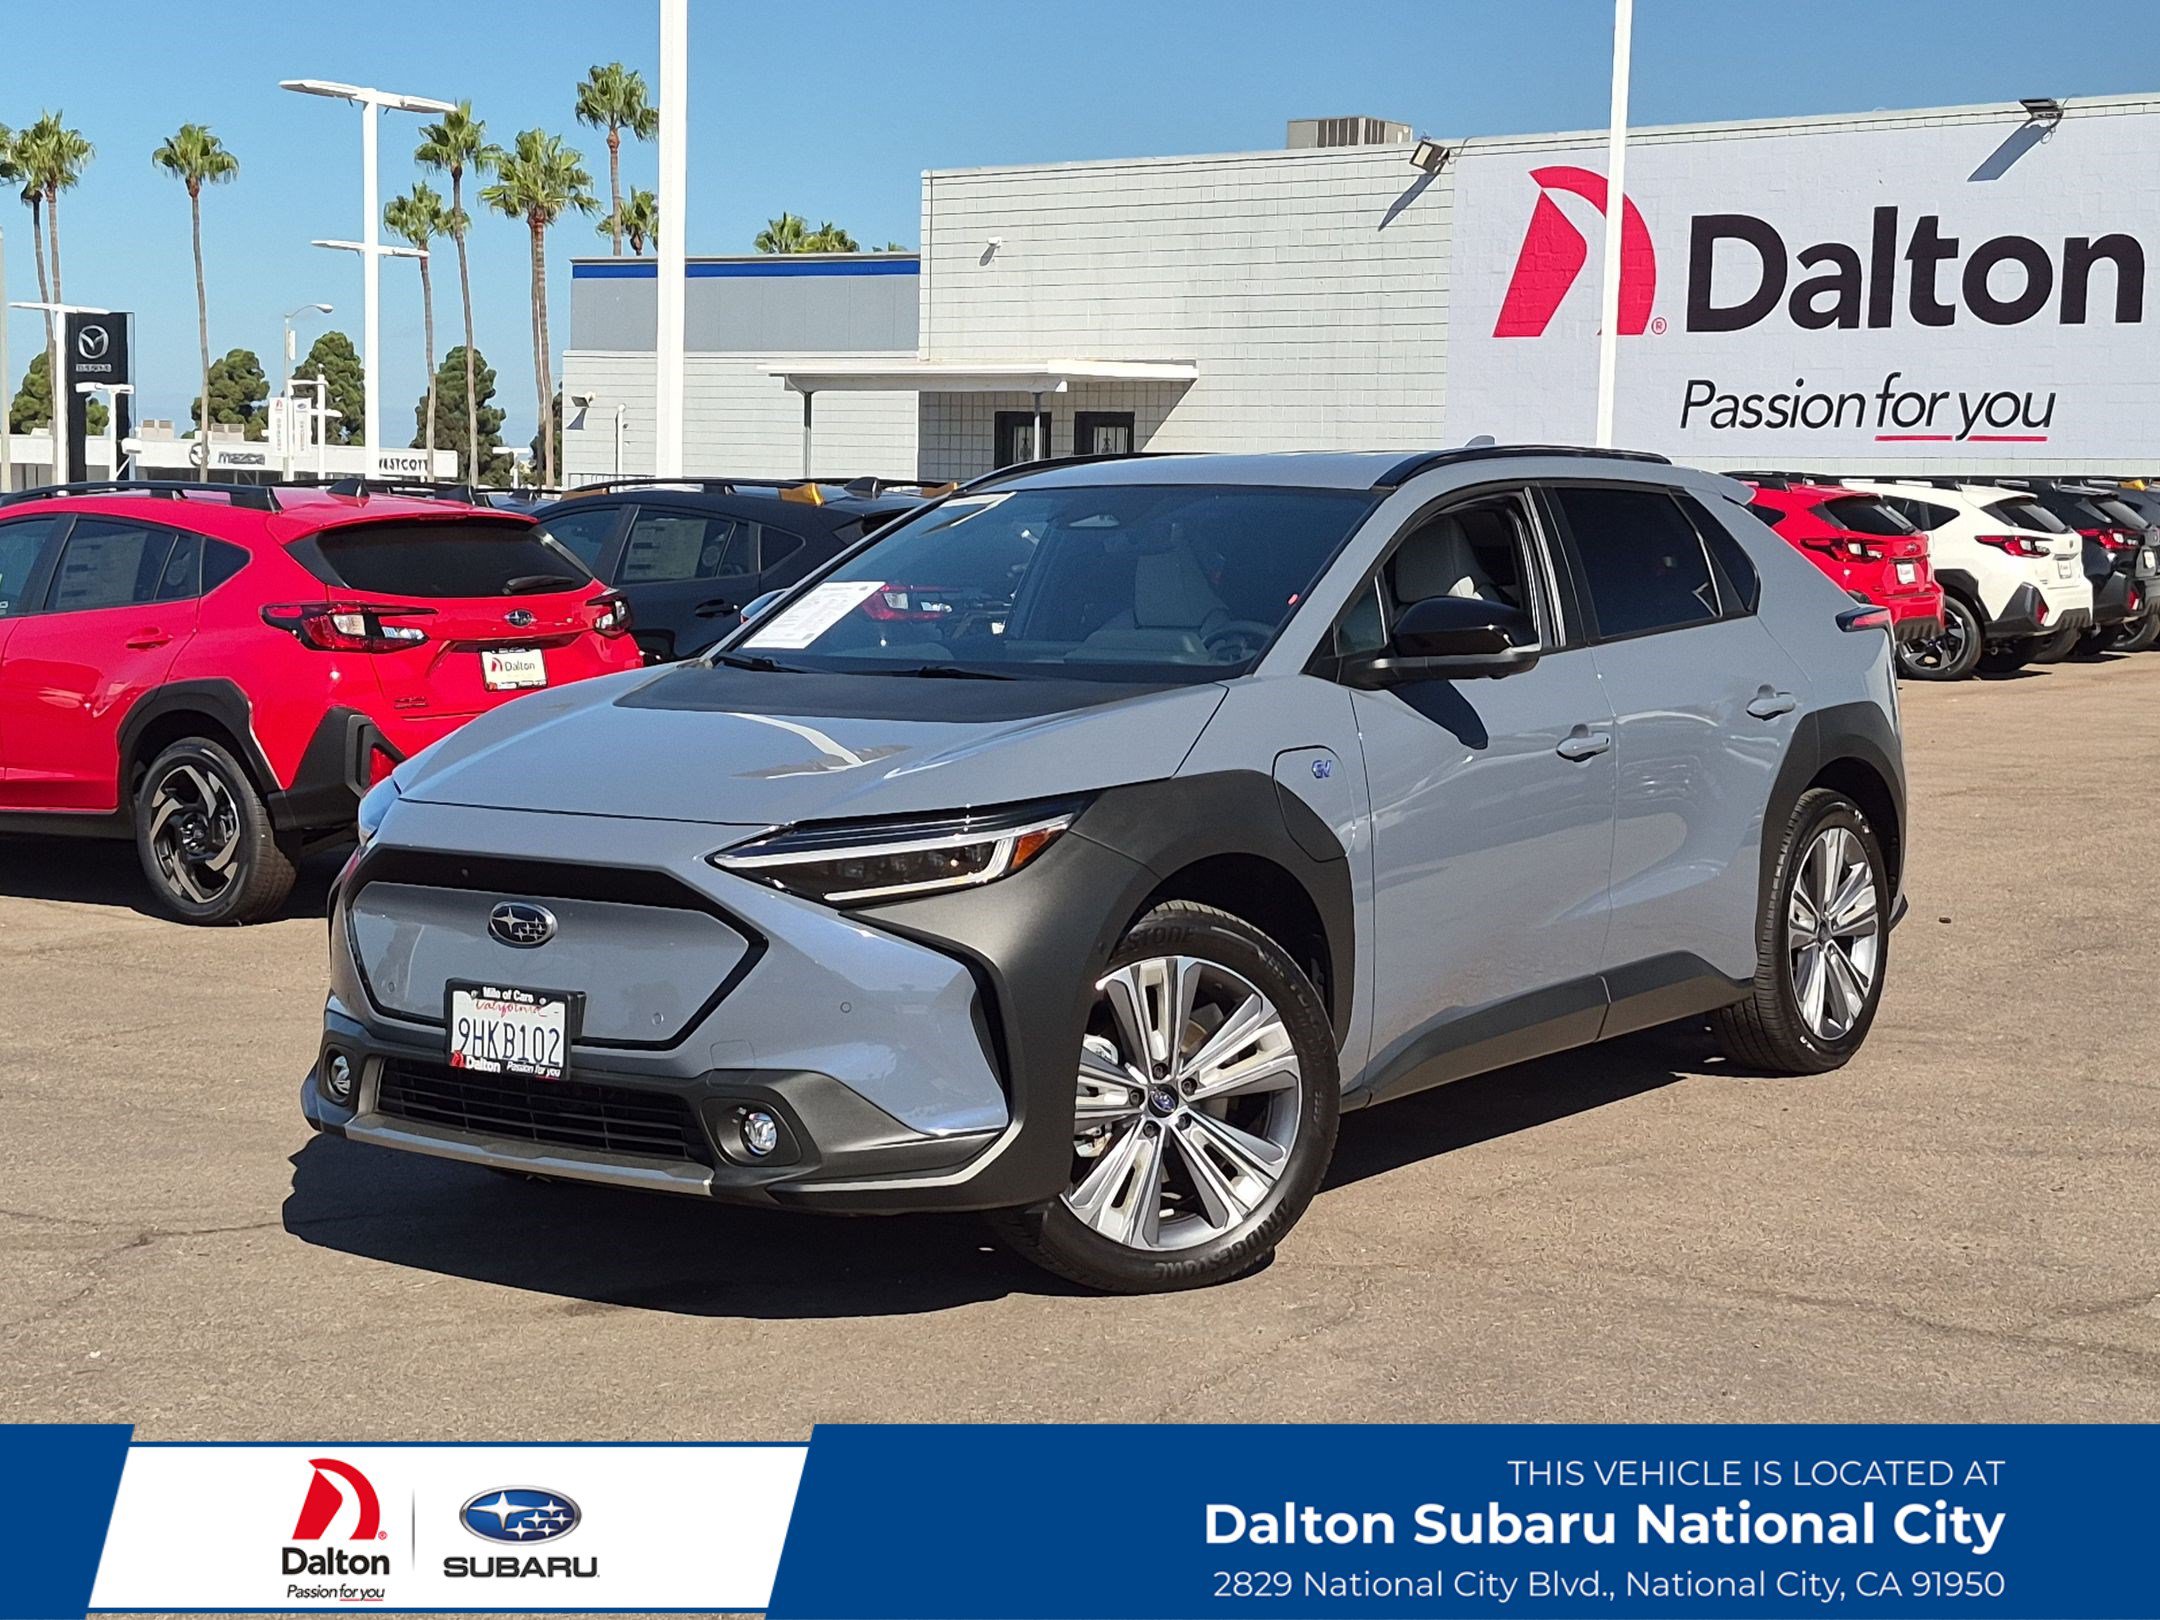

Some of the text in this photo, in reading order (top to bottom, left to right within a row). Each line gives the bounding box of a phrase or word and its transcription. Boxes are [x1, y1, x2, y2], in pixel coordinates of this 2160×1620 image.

[1687, 206, 2144, 332] Dalton
[1680, 372, 2056, 441] Passion for you
[505, 661, 535, 672] Dalton
[483, 987, 533, 1003] Mile of Cars
[458, 1018, 560, 1065] 9HKB102
[465, 1057, 561, 1078] Dalton Passion for you
